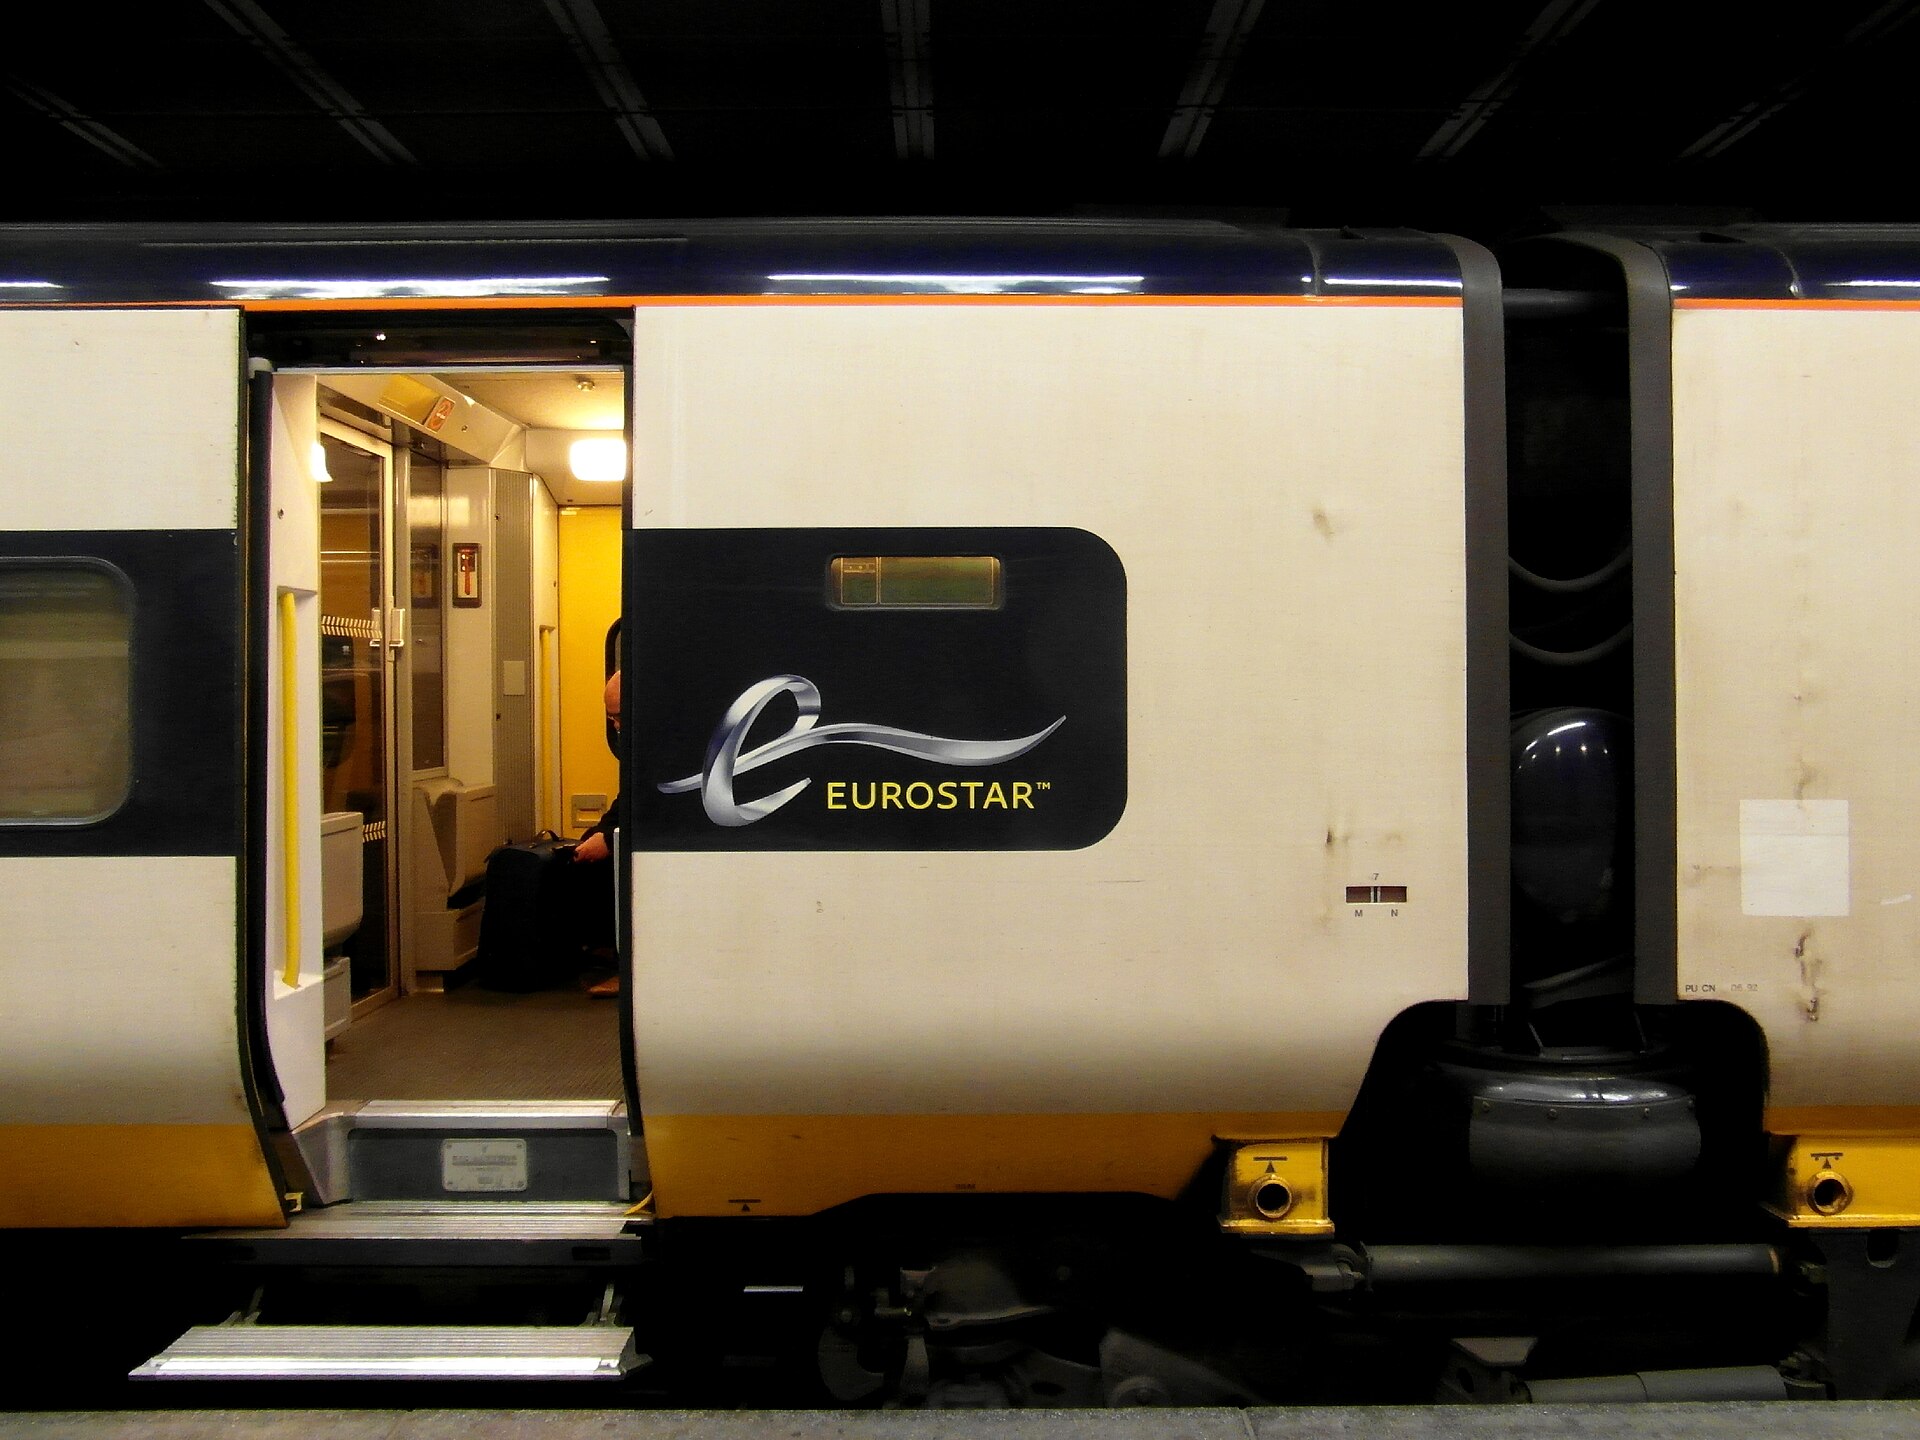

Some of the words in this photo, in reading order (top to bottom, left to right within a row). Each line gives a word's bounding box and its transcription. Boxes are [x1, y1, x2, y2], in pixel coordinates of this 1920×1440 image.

[1391, 909, 1398, 917] N
[1685, 984, 1698, 993] PU
[1702, 984, 1716, 993] CN
